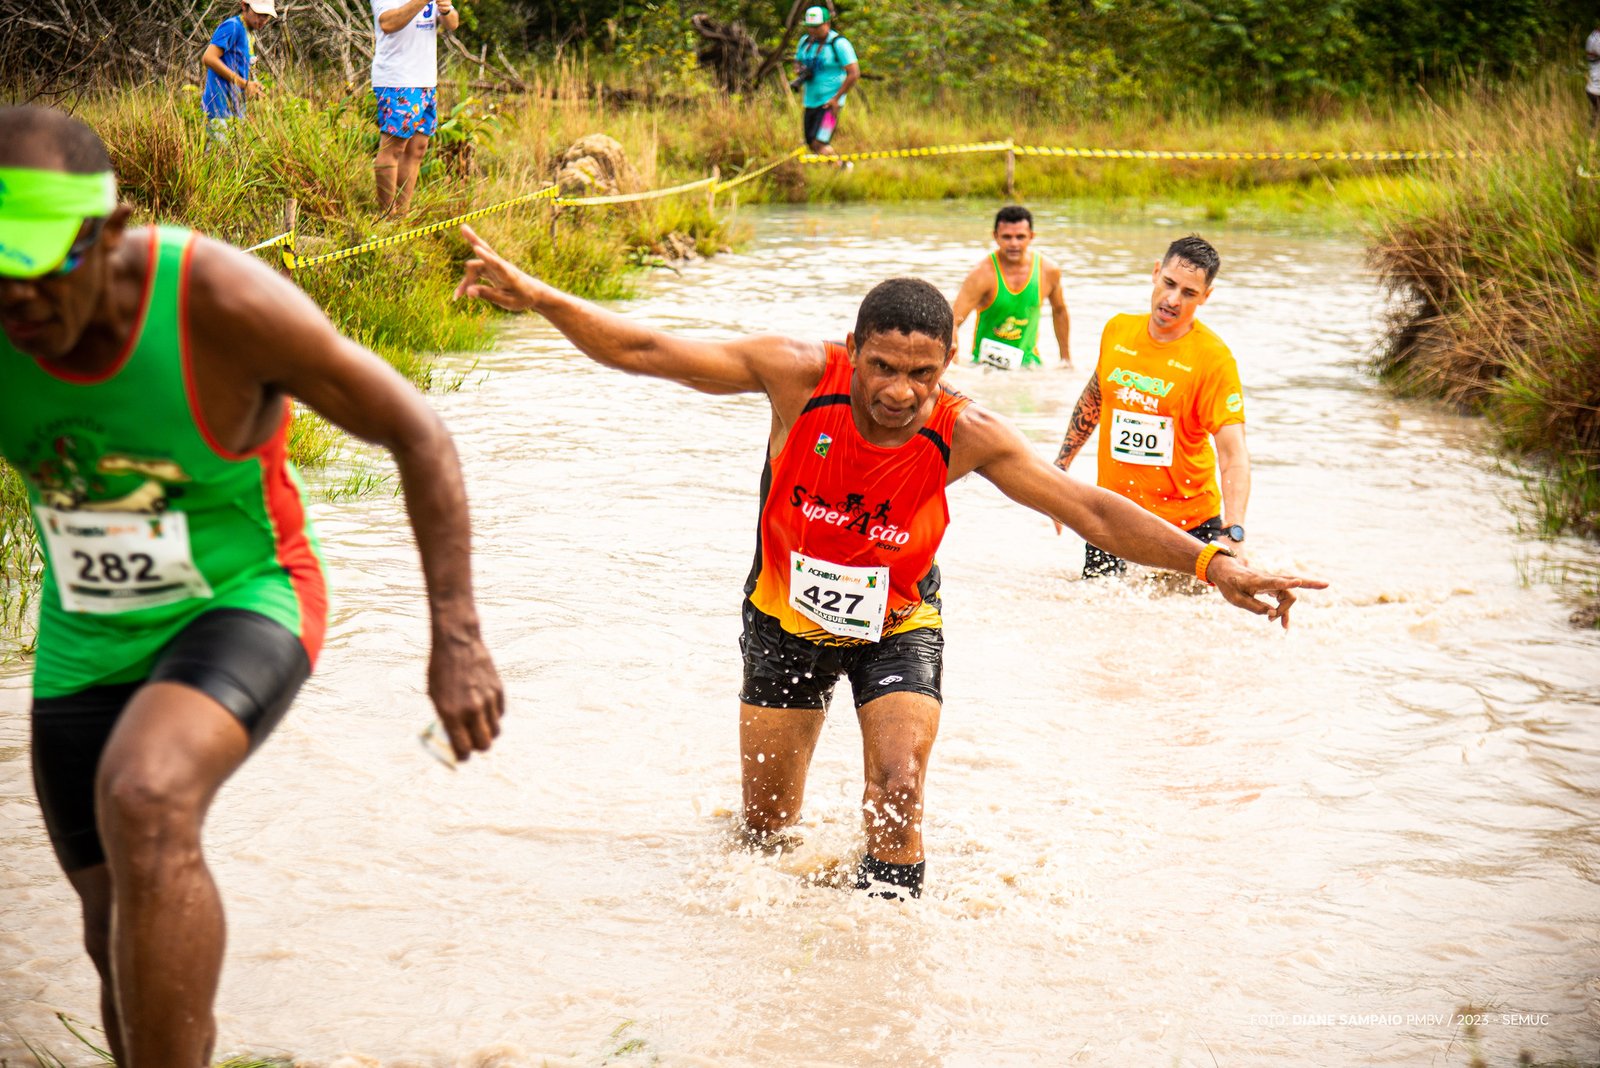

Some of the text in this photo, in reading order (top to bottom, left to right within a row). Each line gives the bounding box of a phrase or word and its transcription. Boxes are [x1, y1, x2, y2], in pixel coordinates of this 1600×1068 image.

[1119, 430, 1157, 449] 290
[875, 541, 901, 552] team
[72, 550, 162, 583] 282
[803, 585, 864, 615] 427
[813, 608, 848, 624] MAXSUEL
